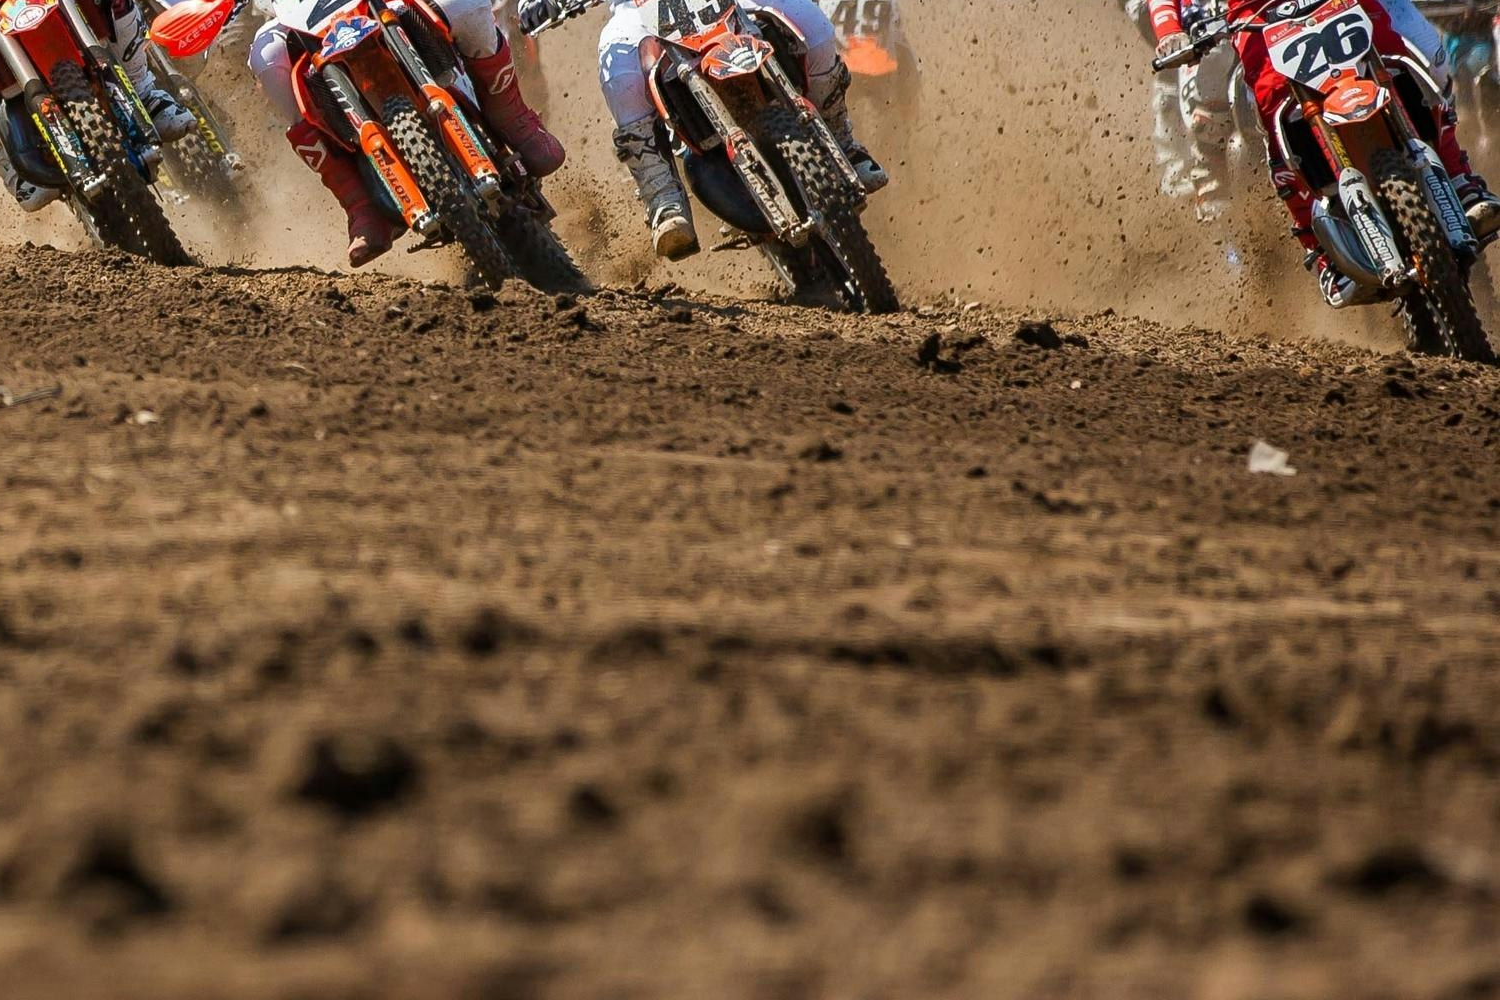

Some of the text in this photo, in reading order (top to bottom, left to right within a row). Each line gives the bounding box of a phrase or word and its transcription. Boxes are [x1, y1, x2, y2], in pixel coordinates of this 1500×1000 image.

[177, 10, 224, 51] ACERBIS
[830, 0, 891, 36] 49
[1281, 12, 1370, 84] 26
[372, 149, 411, 206] DUNLOP
[1426, 174, 1462, 232] Robertson
